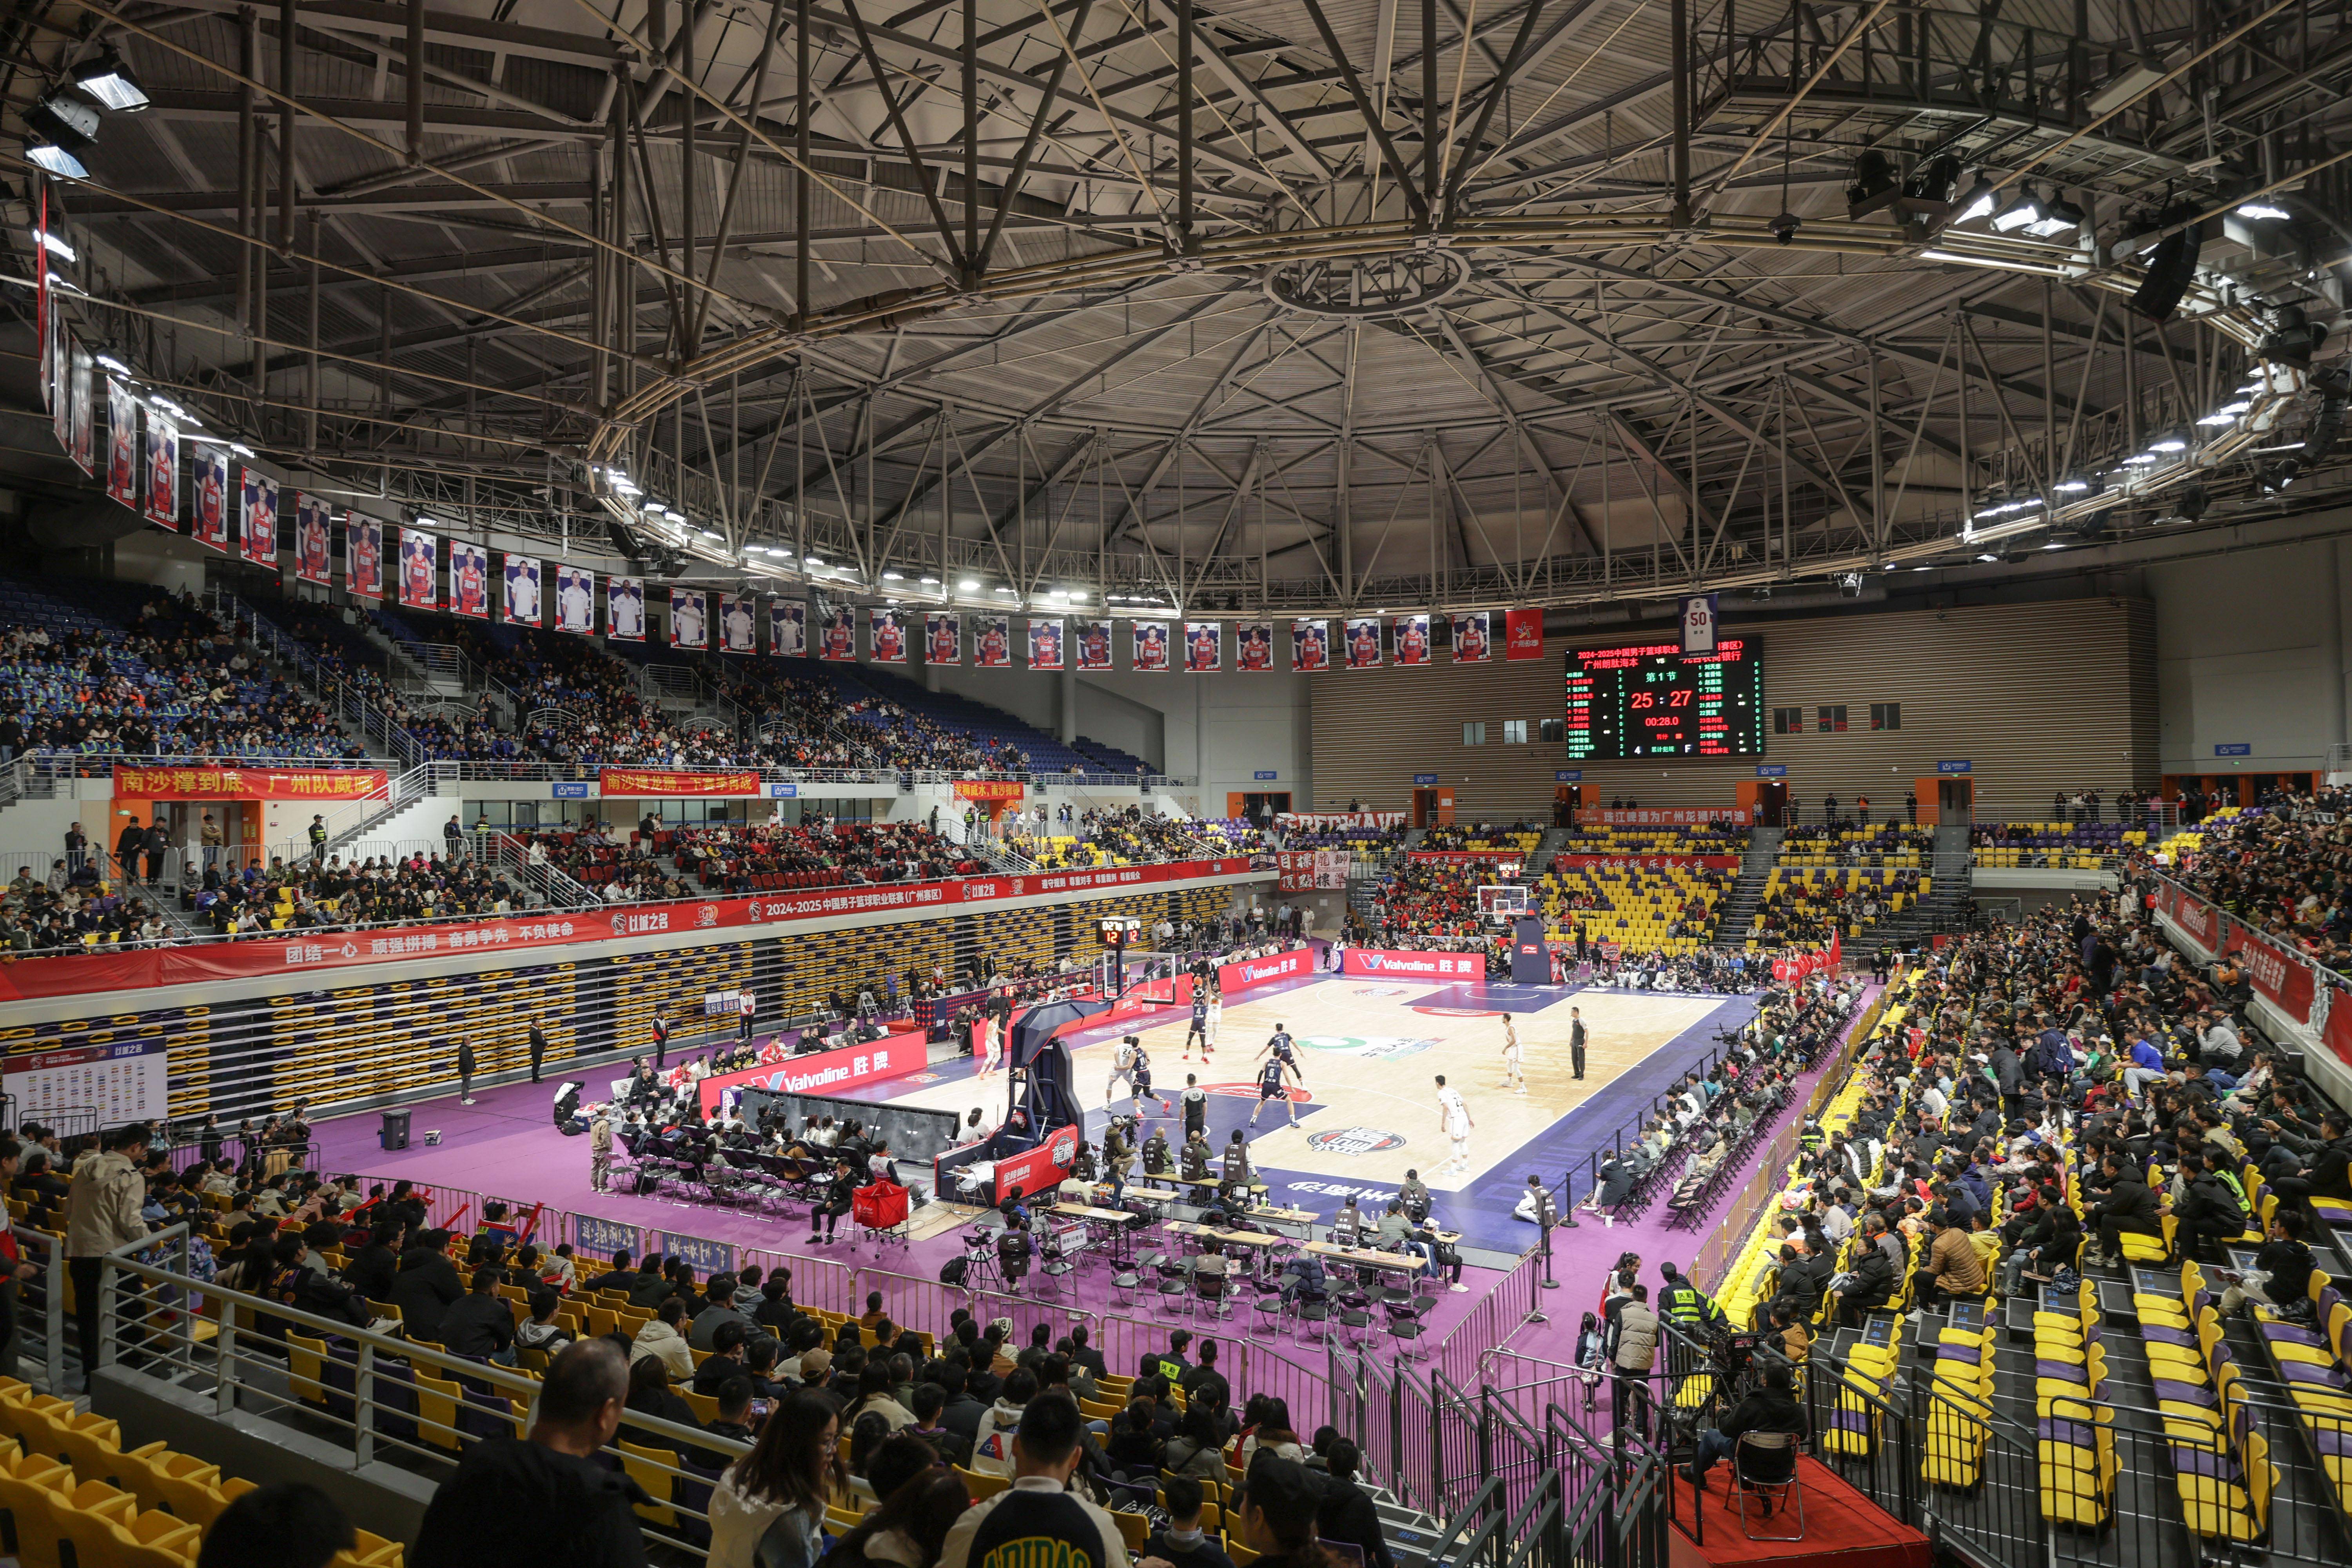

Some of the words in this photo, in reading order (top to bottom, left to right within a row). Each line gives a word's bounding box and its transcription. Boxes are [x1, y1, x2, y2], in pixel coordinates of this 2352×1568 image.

[1690, 612, 1706, 626] 50
[1584, 658, 1638, 670] 广州朗肽海本
[1631, 693, 1653, 709] 25
[1670, 690, 1692, 707] 27
[1645, 717, 1679, 726] 00:28.0
[1634, 746, 1641, 754] 4
[1685, 744, 1691, 753] F
[1604, 810, 1745, 823] 珠江啤酒为广州龙狮队加油
[1280, 853, 1312, 870] 目標
[1042, 877, 1066, 889] 遵守规则
[1069, 875, 1092, 886] 尊重对手
[1095, 873, 1117, 884] 尊重裁判
[1120, 871, 1141, 881] 尊重观众
[972, 884, 995, 898] 以城之名
[766, 899, 822, 916] 2024-2025
[629, 913, 668, 933] 以城之名
[286, 942, 358, 965] 团结一心
[372, 934, 437, 955] 顽强拼搏
[449, 927, 508, 949] 奋勇争先
[519, 922, 574, 941] 不负使命
[1107, 932, 1118, 943] 12
[1252, 965, 1280, 980] Valvoline
[1382, 959, 1436, 972] Valvoline
[1439, 959, 1472, 973] 胜牌
[706, 1002, 722, 1014] 025
[723, 1000, 739, 1010] 027
[1196, 1007, 1202, 1015] 4
[785, 1066, 850, 1092] Valvoline
[853, 1050, 889, 1076] 胜牌
[1269, 1068, 1275, 1077] 6
[1003, 1165, 1031, 1183] 金陵体育
[1016, 1174, 1030, 1182] SPORTS
[1062, 1234, 1084, 1245] 摄影记者席
[1161, 1364, 1176, 1374] 执勤
